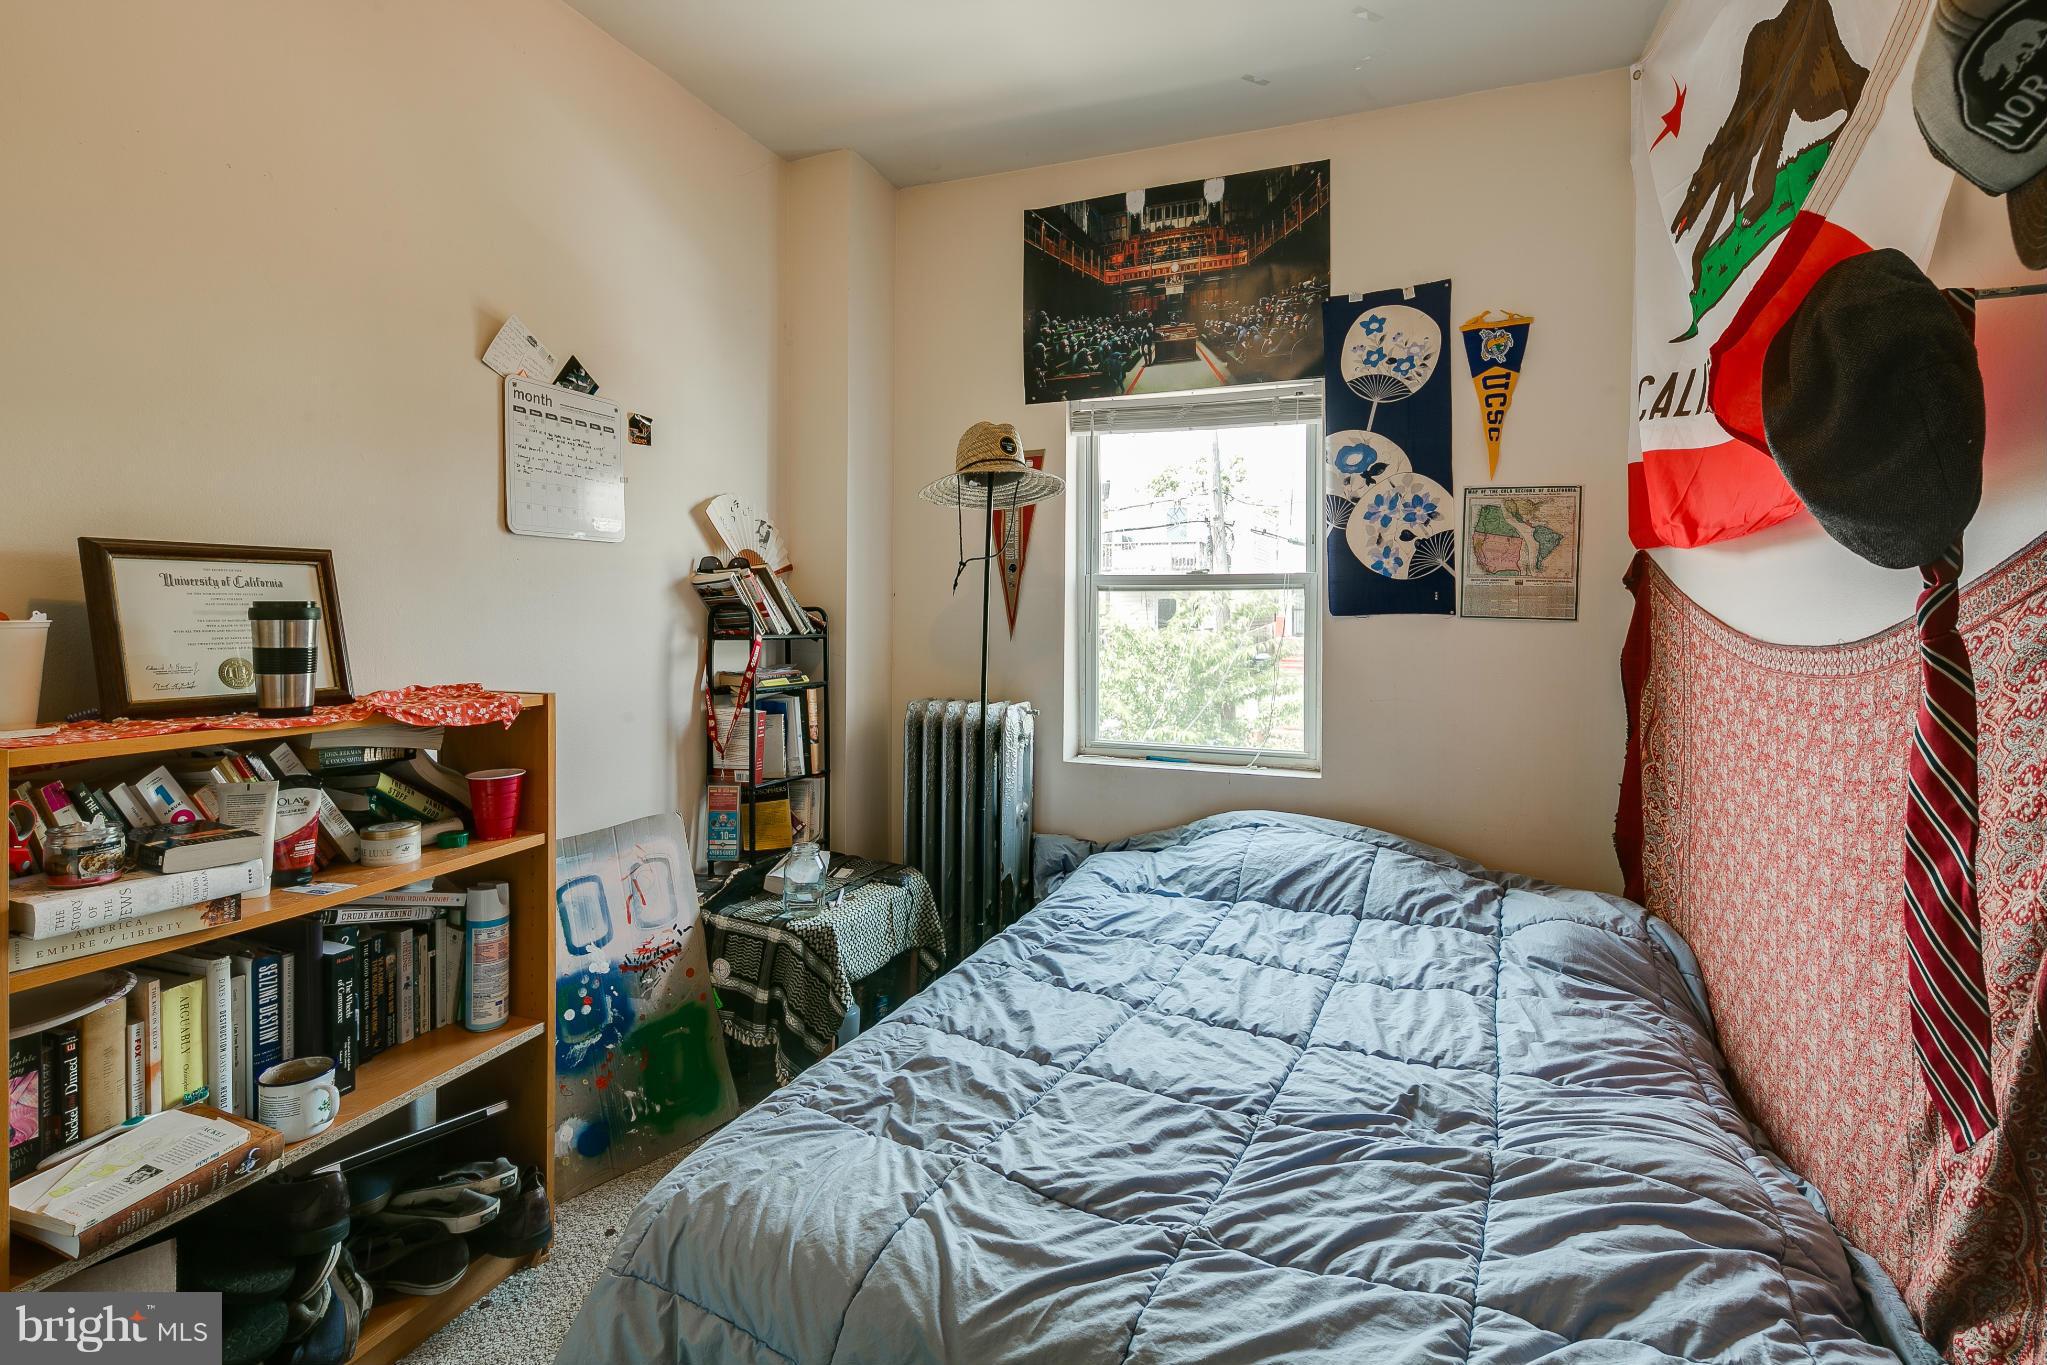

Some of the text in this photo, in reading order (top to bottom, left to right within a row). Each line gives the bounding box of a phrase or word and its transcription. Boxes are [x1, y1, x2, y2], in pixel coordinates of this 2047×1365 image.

[513, 388, 553, 407] month
[1639, 358, 1713, 422] CALI
[1481, 371, 1511, 442] UCSC
[159, 572, 283, 589] University of California
[324, 751, 338, 759] JOHN
[345, 756, 363, 764] SMITH
[154, 784, 175, 806] 1
[277, 797, 305, 807] OLAY
[387, 786, 407, 802] STUFF
[84, 797, 98, 814] THE
[422, 806, 440, 820] WOOD
[425, 799, 445, 813] JAMES
[333, 813, 354, 838] CONSENT
[720, 831, 729, 840] 10
[191, 876, 200, 901] SIMON
[201, 869, 209, 901] SCHAMA
[71, 898, 83, 931] STORY
[88, 905, 98, 919] OF
[103, 898, 113, 920] THE
[119, 887, 133, 922] JEWS
[341, 910, 412, 921] CRUDE AWAKENING
[54, 909, 66, 931] THE
[36, 920, 184, 959] EMPIRE of LIBERTY
[258, 963, 279, 1005] SEIZING
[337, 979, 344, 987] of
[345, 978, 353, 1019] The Wheels
[151, 1017, 158, 1025] IN
[179, 996, 191, 1055] ARGUABLY
[259, 1004, 279, 1046] DESTINY
[134, 1037, 142, 1058] FOX
[218, 978, 228, 1109] DAYS OF DESTRUCTION DAYS OF REVOLT
[103, 1047, 114, 1078] Wealth
[64, 1056, 78, 1096] Dimed
[66, 1106, 79, 1143] Nickel
